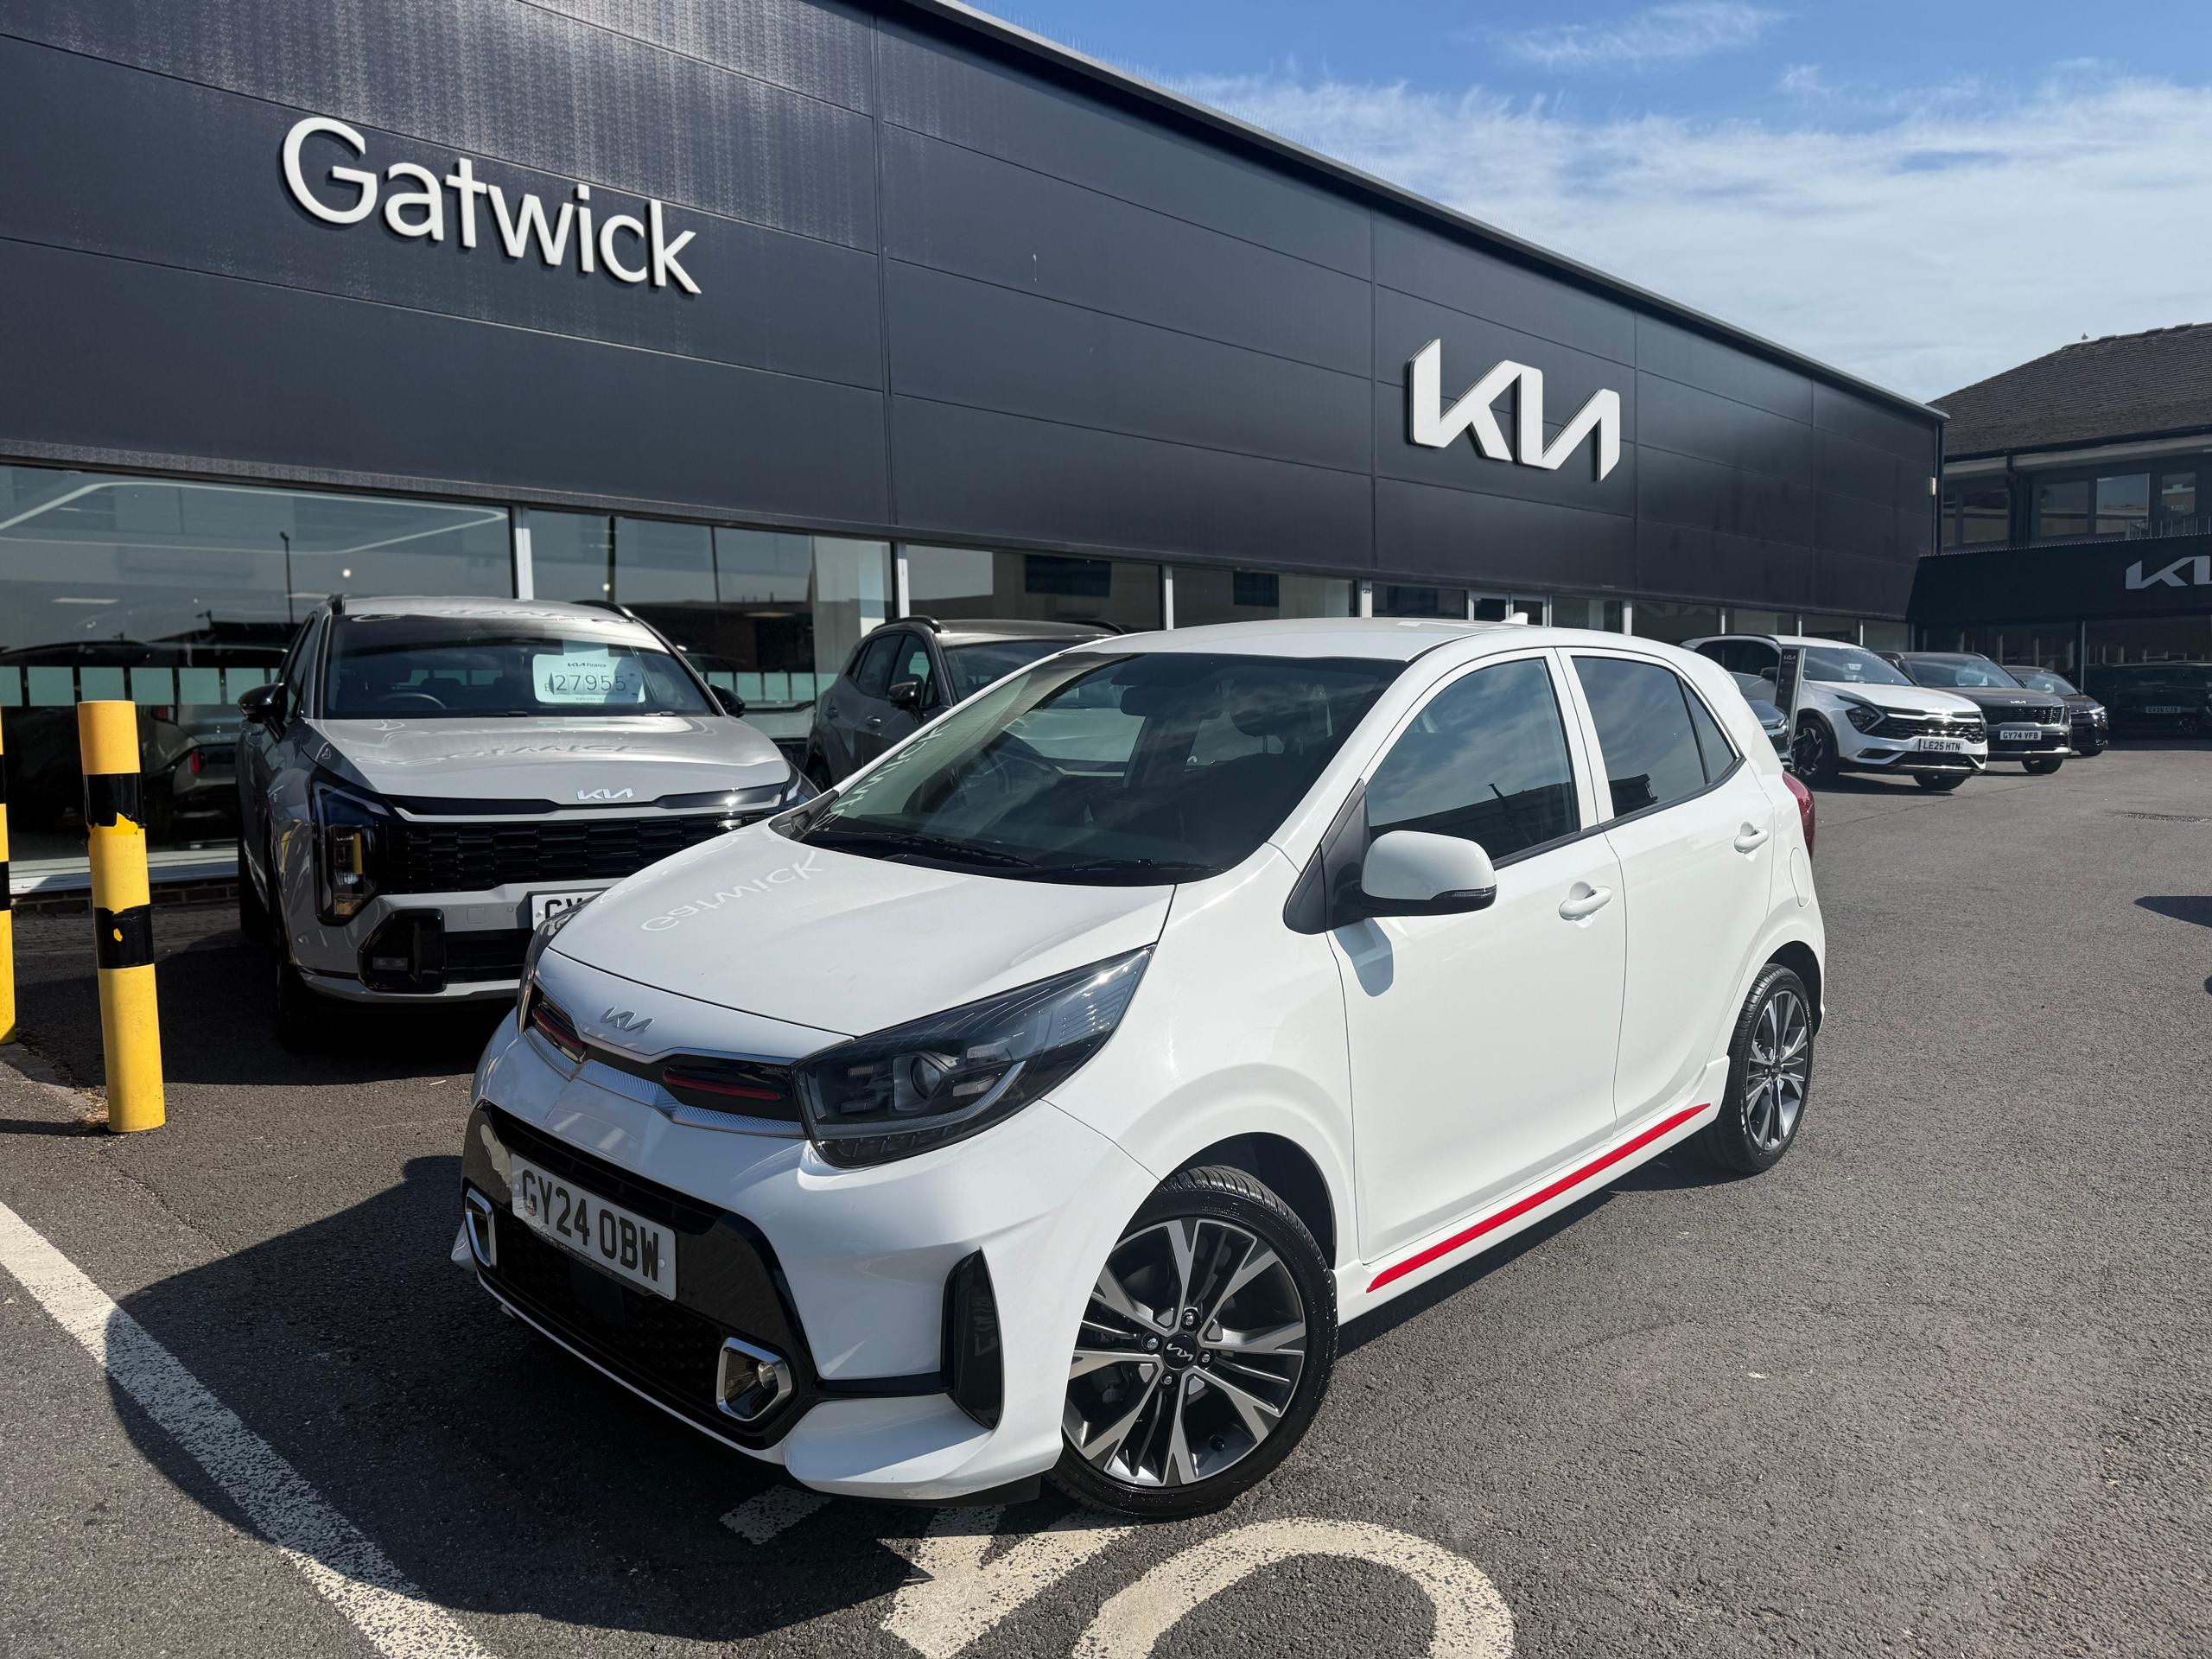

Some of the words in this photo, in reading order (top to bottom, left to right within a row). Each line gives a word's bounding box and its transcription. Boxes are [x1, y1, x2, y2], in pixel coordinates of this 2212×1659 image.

[283, 117, 702, 295] Gatwick
[1409, 338, 1621, 482] KIA
[2126, 556, 2212, 589] KI
[1923, 741, 1944, 750] LE25
[1945, 742, 1961, 751] HTN
[576, 788, 633, 800] KIA
[600, 1006, 656, 1033] KIA
[522, 1168, 590, 1246] GY24
[599, 1208, 659, 1282] OBW
